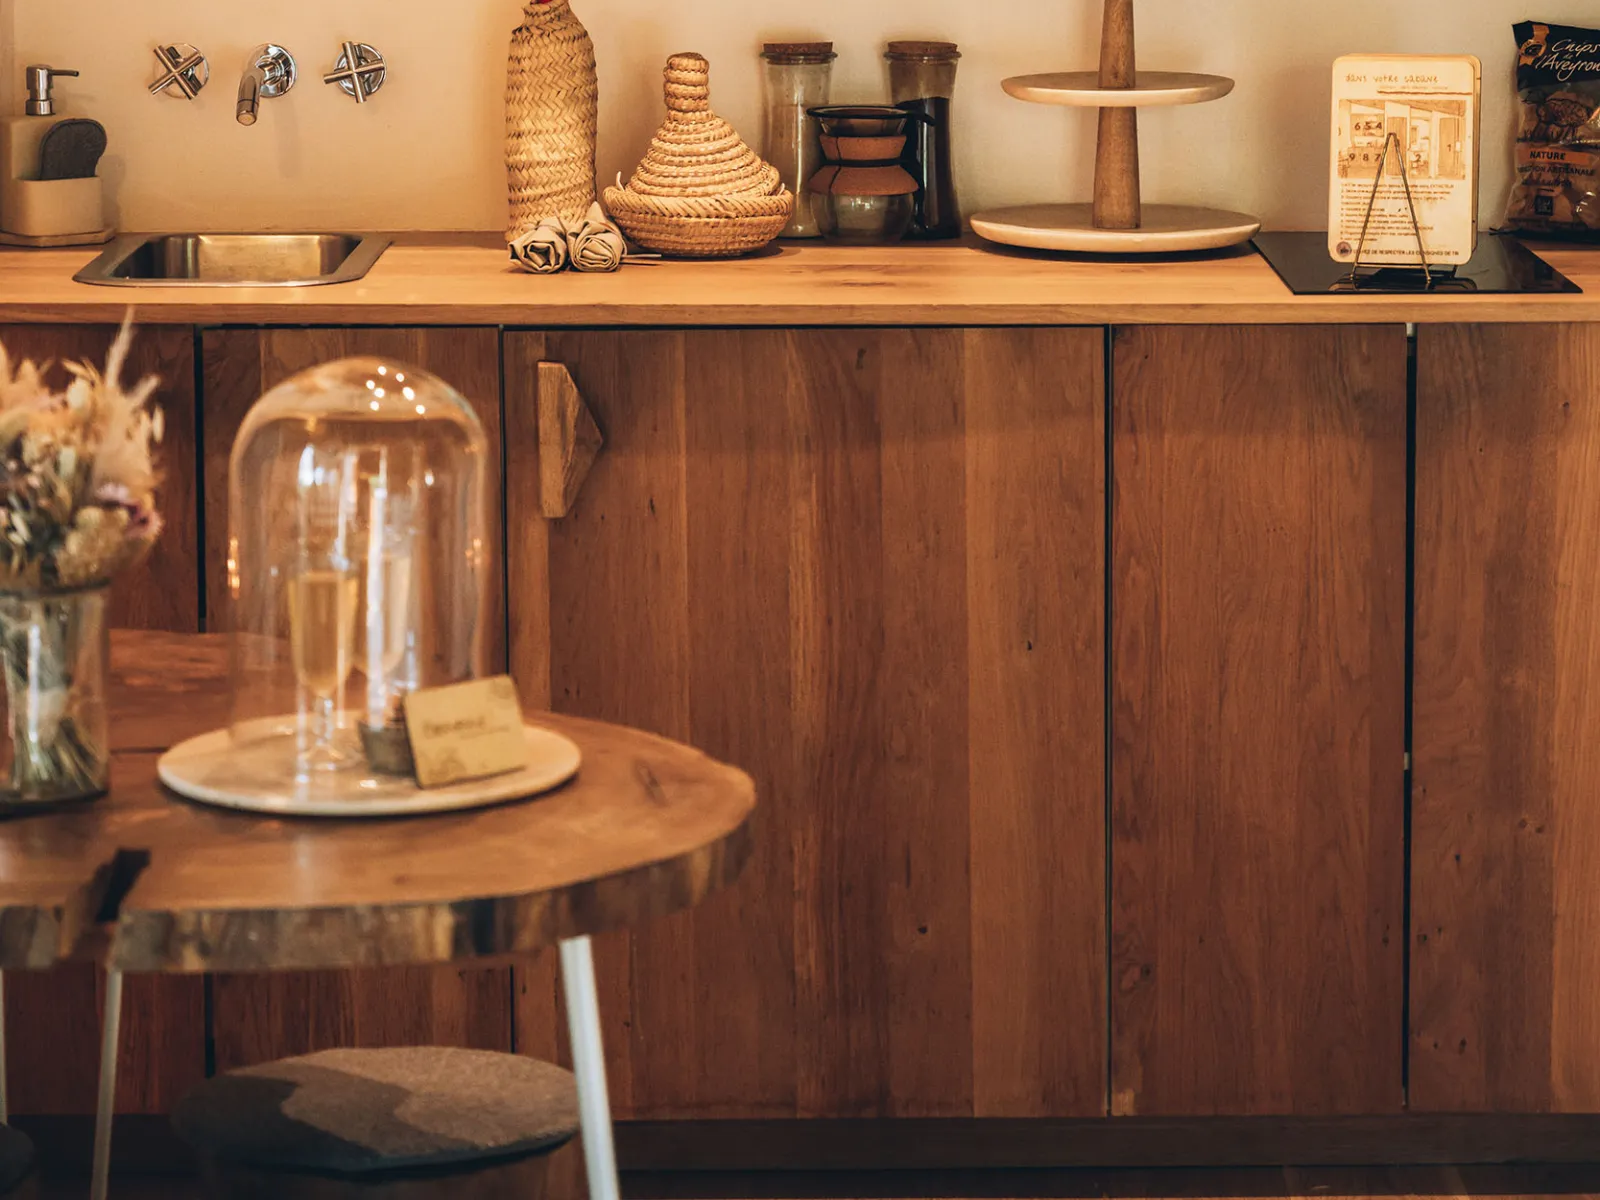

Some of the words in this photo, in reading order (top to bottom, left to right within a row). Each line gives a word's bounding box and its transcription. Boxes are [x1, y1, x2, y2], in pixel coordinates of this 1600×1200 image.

[1354, 122, 1361, 131] 6
[1375, 122, 1383, 131] 4
[1349, 152, 1356, 161] 9
[1362, 152, 1369, 161] 8
[1374, 153, 1381, 161] 7
[1414, 153, 1422, 162] 2
[1529, 150, 1566, 160] NATURE
